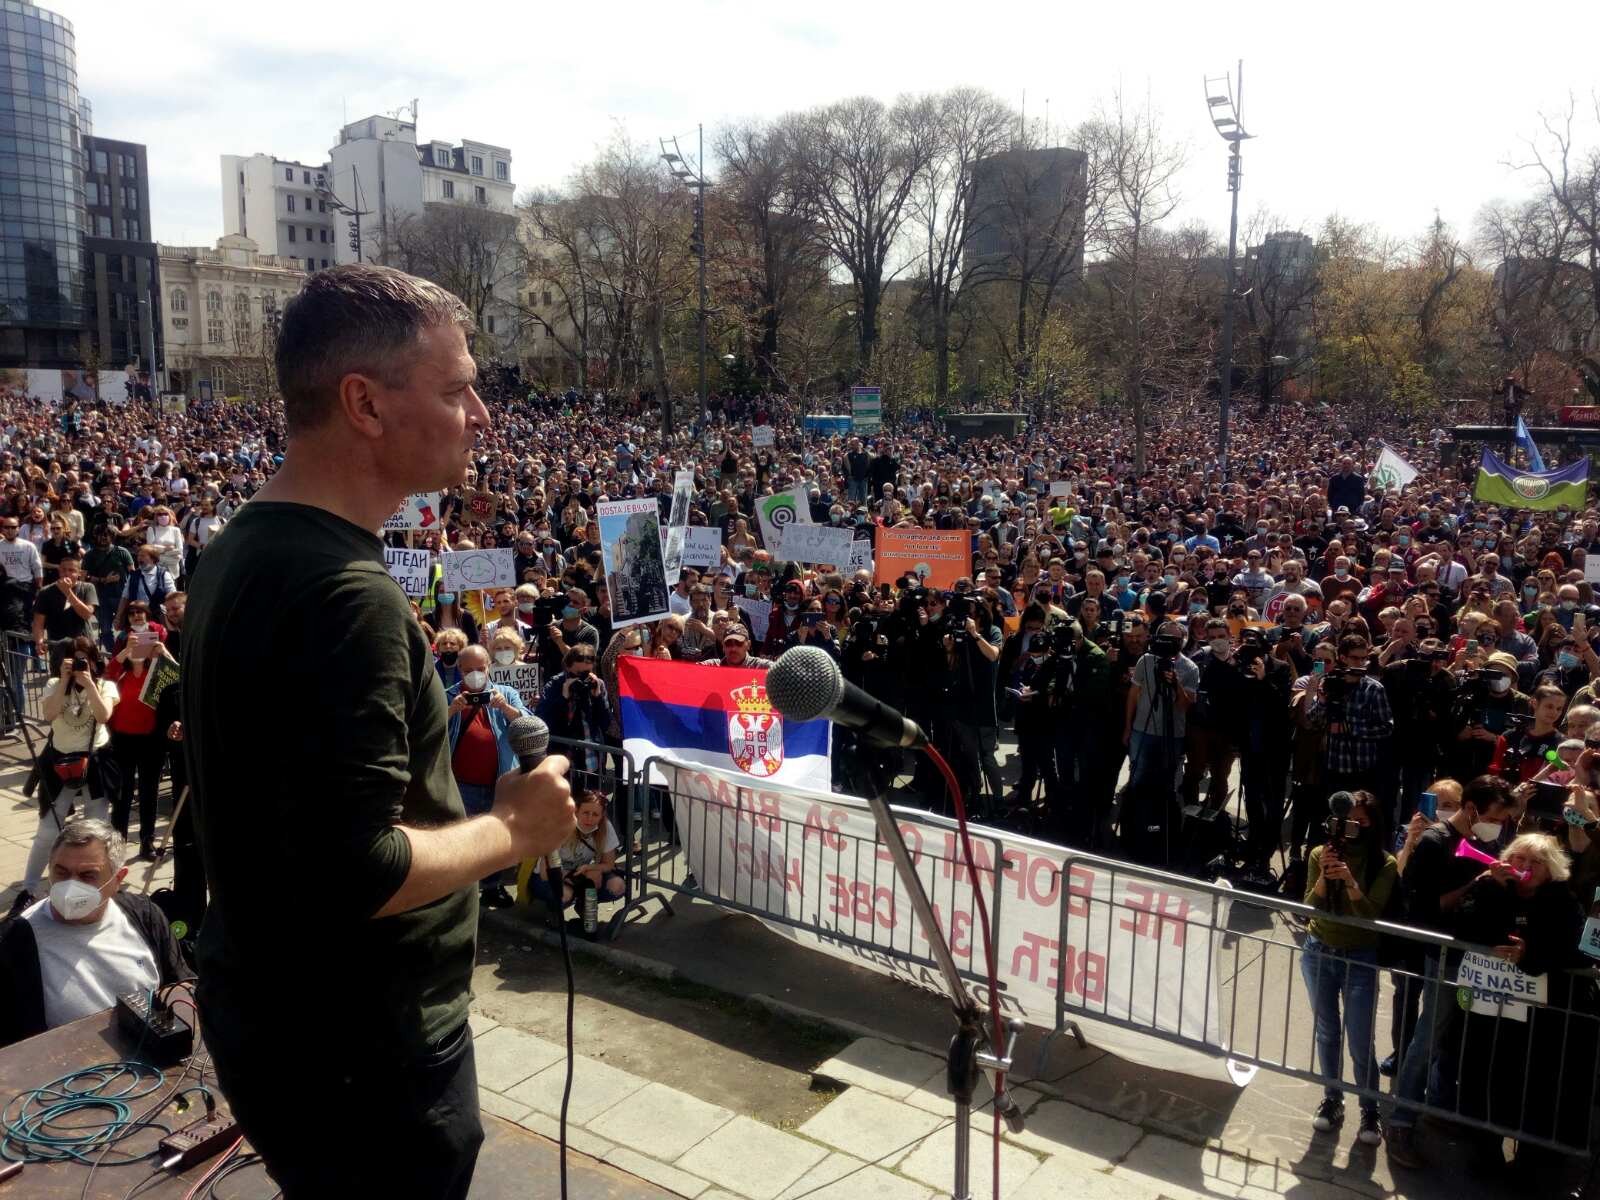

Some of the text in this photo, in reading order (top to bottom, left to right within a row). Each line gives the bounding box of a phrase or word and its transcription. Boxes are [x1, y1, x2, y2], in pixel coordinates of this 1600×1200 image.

[472, 500, 490, 512] STOP
[600, 506, 622, 515] DOSTA
[516, 667, 537, 679] СМО
[1460, 965, 1537, 995] SVE NAŠE
